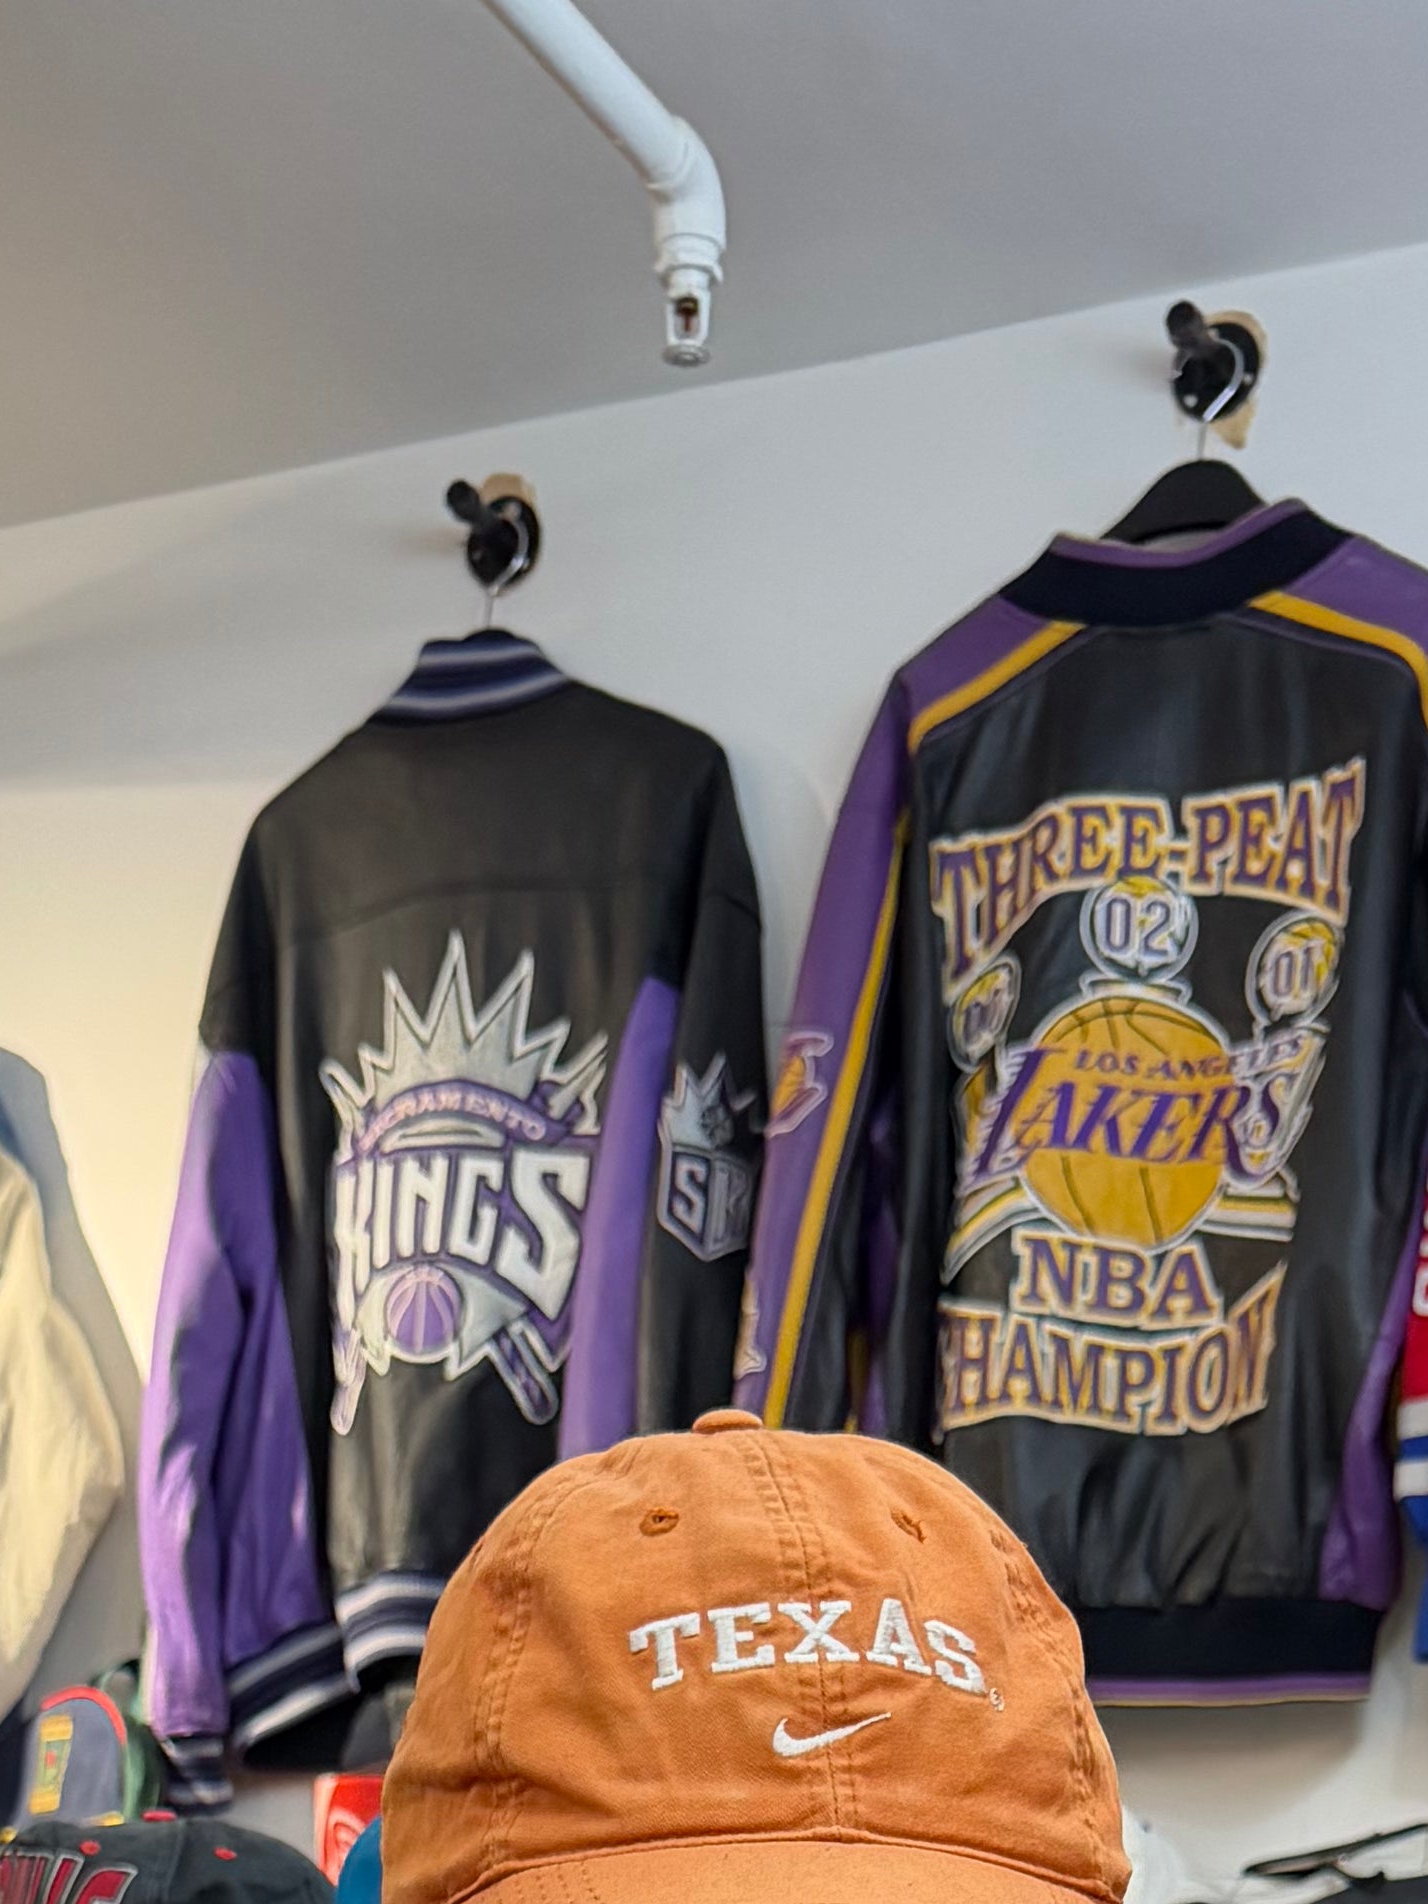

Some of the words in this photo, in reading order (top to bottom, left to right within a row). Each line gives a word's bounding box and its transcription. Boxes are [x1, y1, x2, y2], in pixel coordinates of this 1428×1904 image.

[932, 762, 1365, 992] THREE-PEAT
[1102, 898, 1175, 955] 02
[1272, 945, 1316, 999] 01
[1074, 1049, 1140, 1077] LOS
[1145, 1038, 1303, 1079] ANGELES
[968, 1047, 1281, 1181] LAKERS
[334, 1148, 592, 1336] KINGS
[1015, 1231, 1219, 1325] NBA
[942, 1272, 1281, 1434] HAMPION
[628, 1597, 988, 1697] TEXAS
